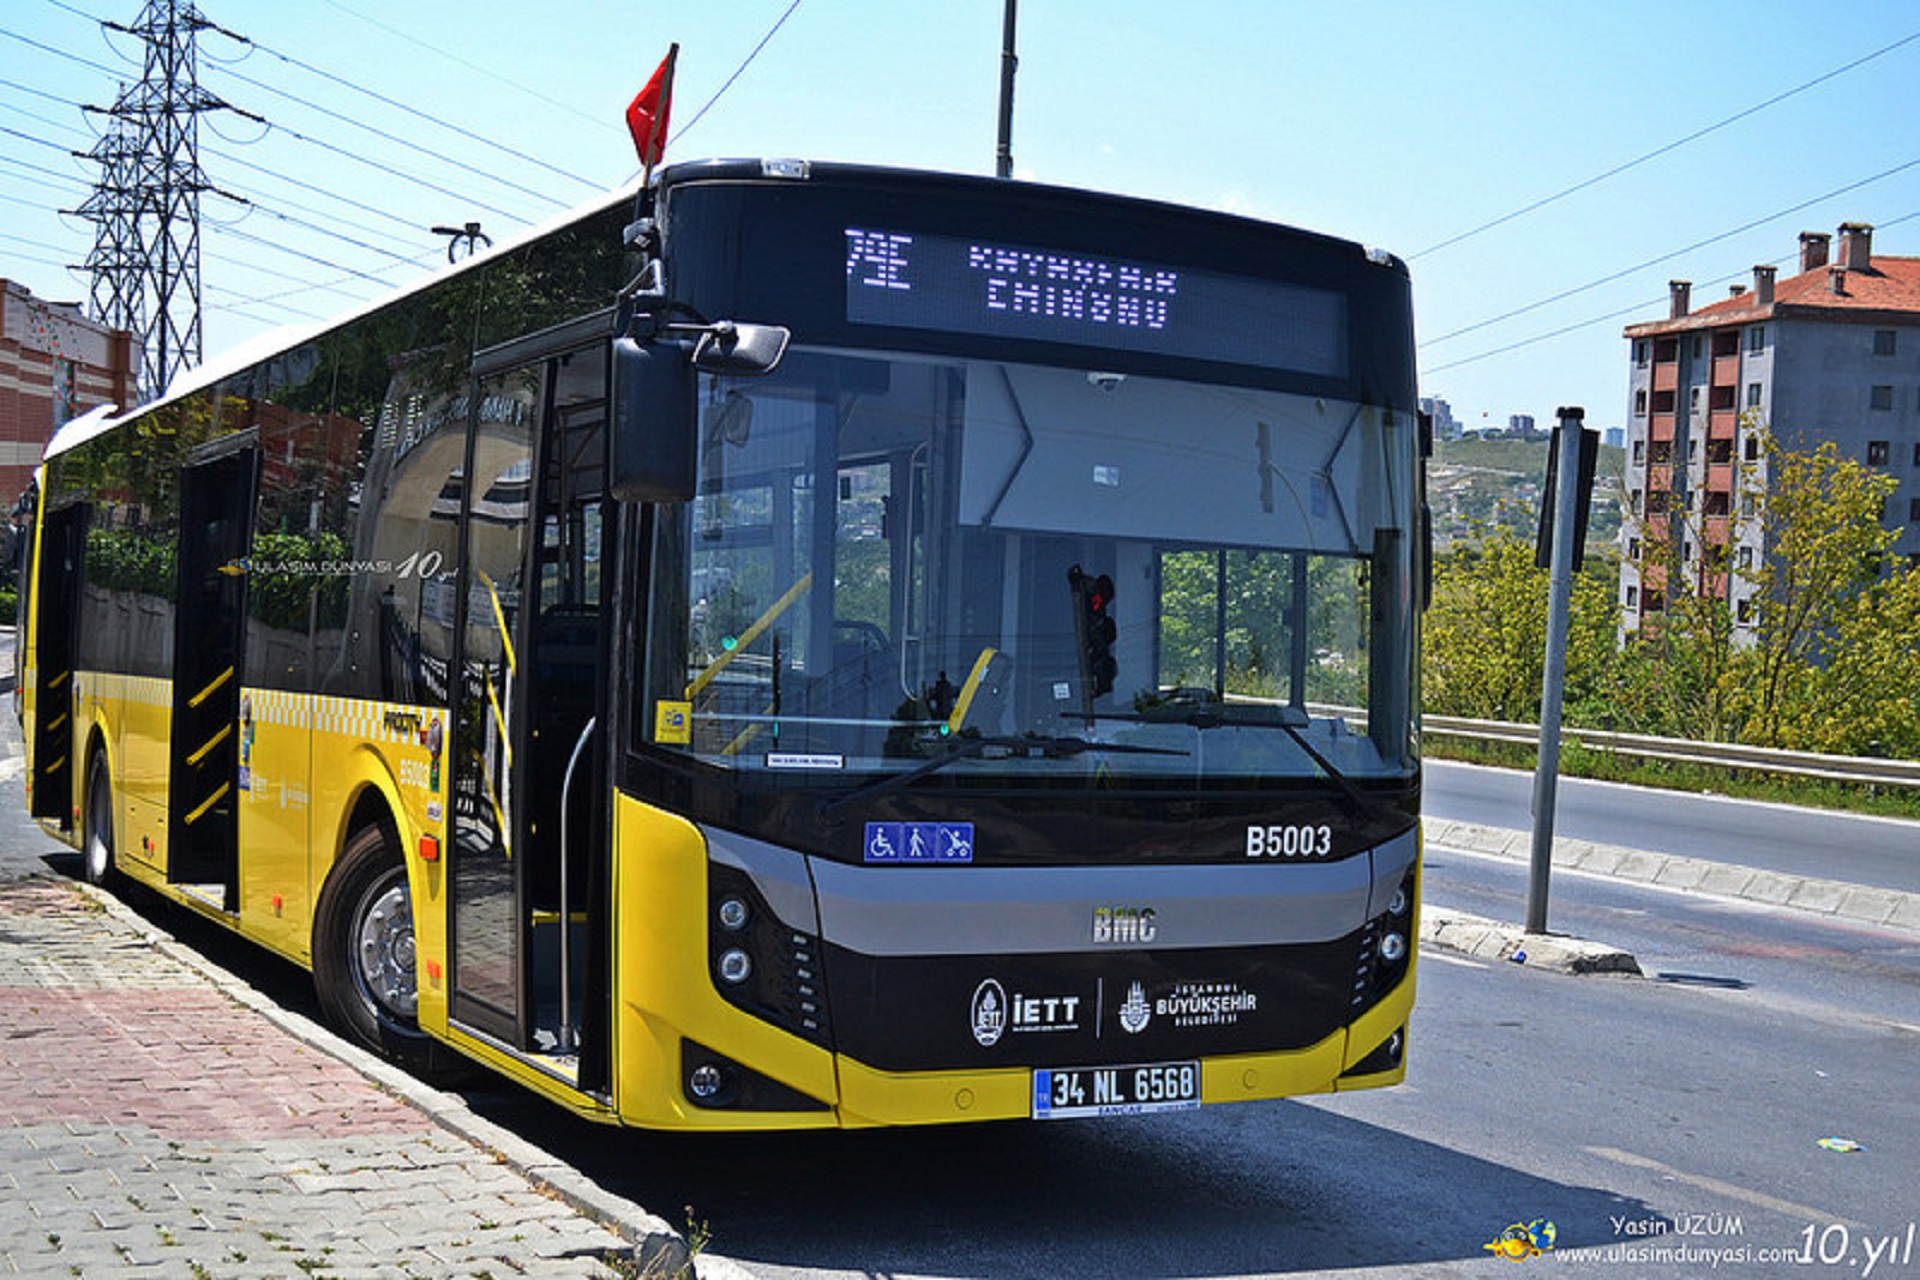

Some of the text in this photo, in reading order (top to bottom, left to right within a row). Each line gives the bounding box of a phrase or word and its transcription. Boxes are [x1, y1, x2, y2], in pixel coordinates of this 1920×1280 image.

[844, 229, 912, 289] 79E
[1246, 825, 1332, 857] B5003
[1093, 907, 1156, 943] BMC
[1013, 993, 1080, 1024] İETT
[1155, 989, 1257, 1017] BÜYÜKŞEHİR
[1053, 1065, 1195, 1106] 34 NL 6568
